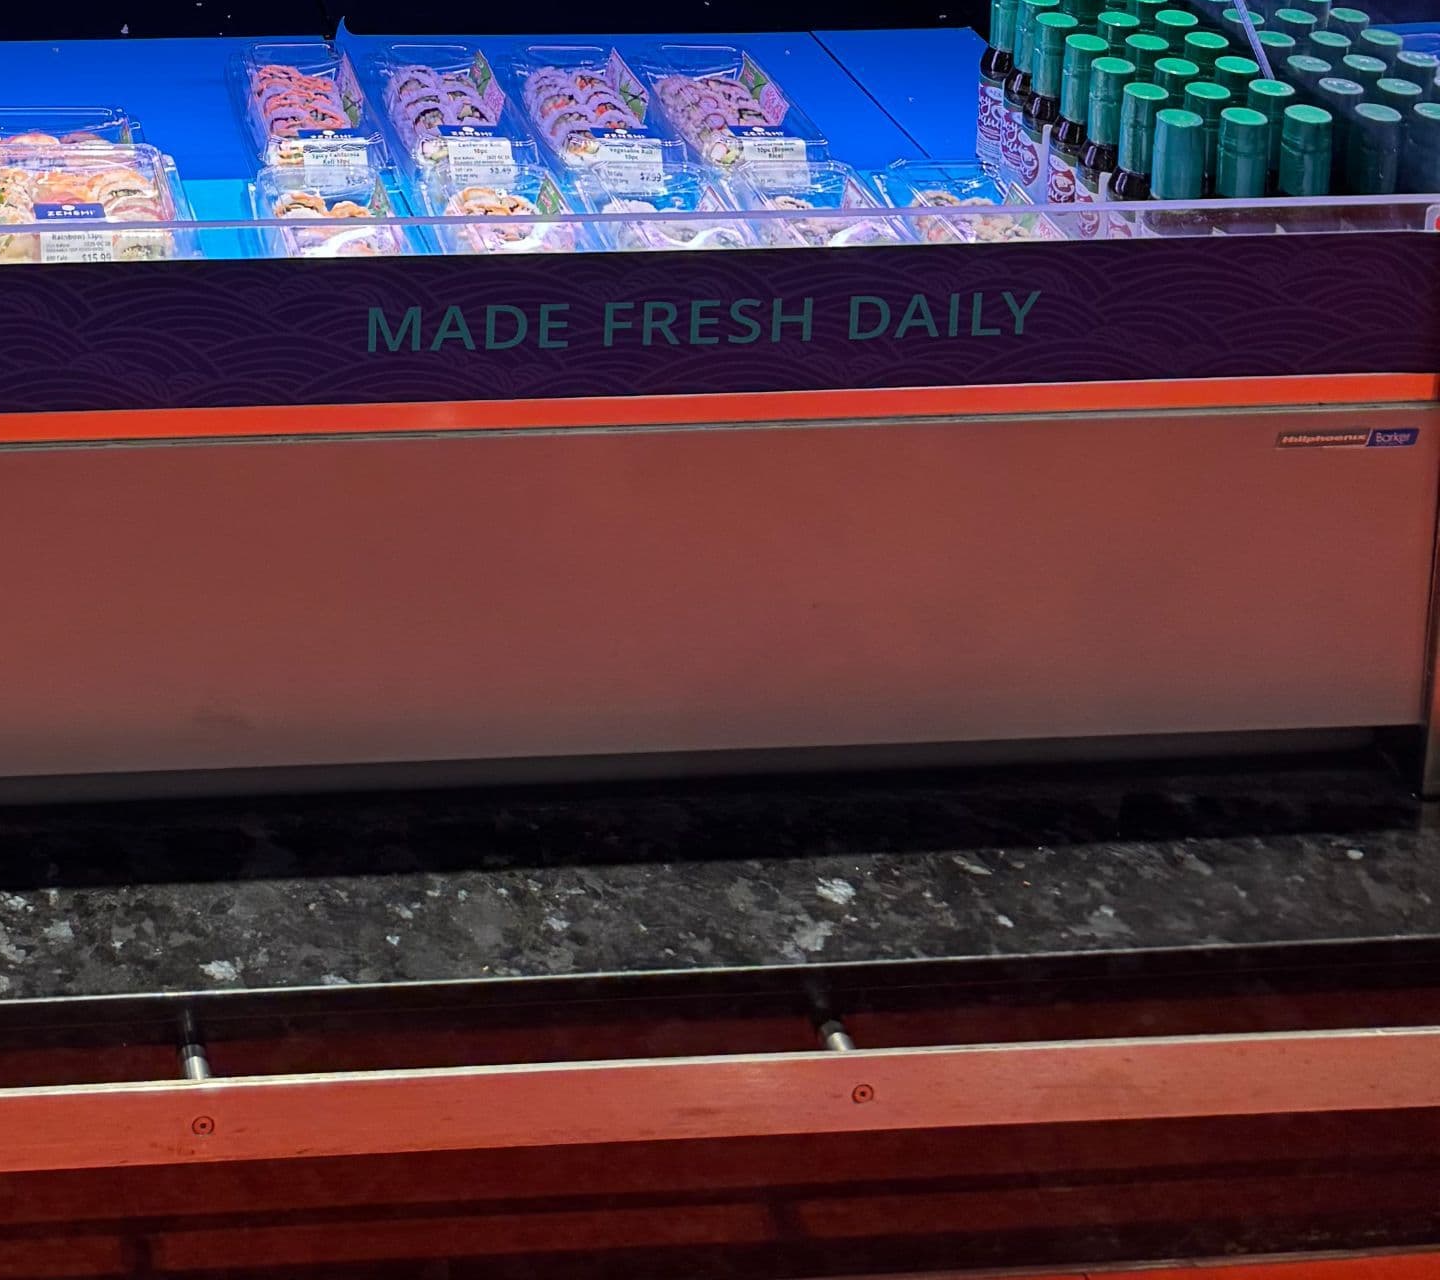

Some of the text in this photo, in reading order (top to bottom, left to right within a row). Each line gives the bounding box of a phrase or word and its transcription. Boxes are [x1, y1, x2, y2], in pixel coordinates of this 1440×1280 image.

[366, 289, 1042, 354] MADE FRESH DAILY
[1375, 432, 1411, 443] Barker
